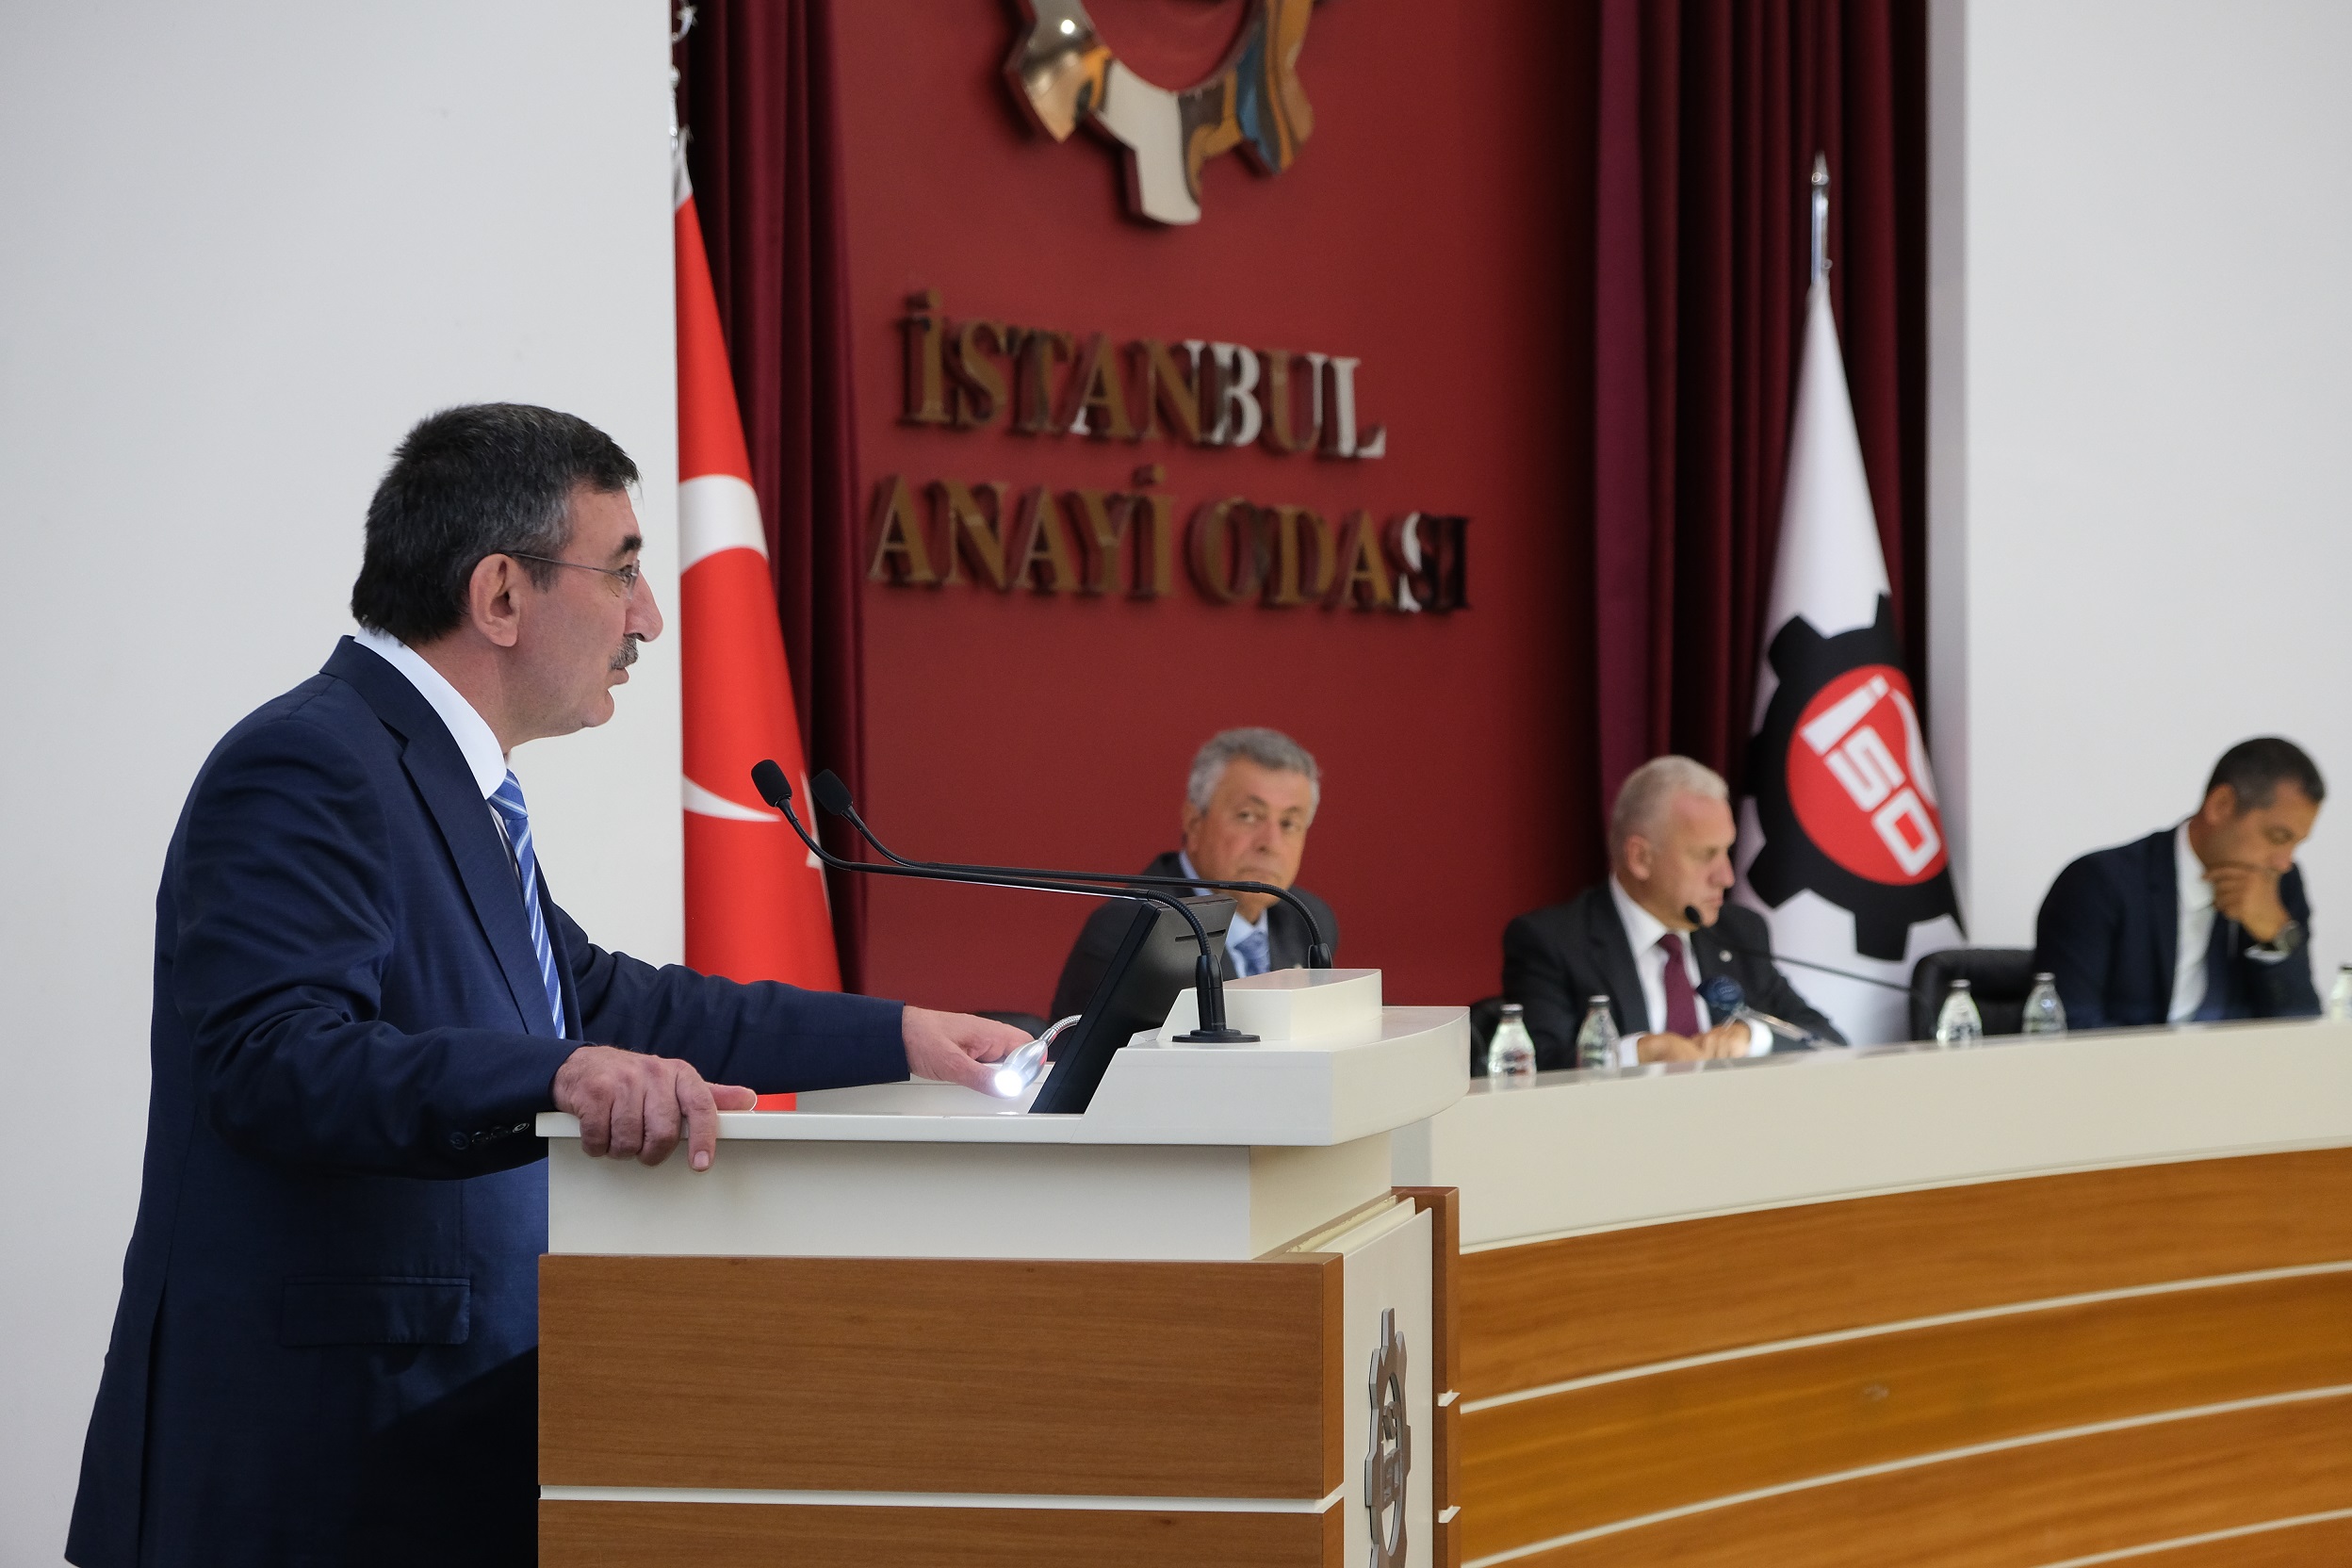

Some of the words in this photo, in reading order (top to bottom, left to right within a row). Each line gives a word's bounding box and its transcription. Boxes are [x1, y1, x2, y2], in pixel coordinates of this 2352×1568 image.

[900, 290, 1386, 460] İSTANBUL
[868, 465, 1178, 600] ANAYİ
[1187, 497, 1471, 614] ODASI
